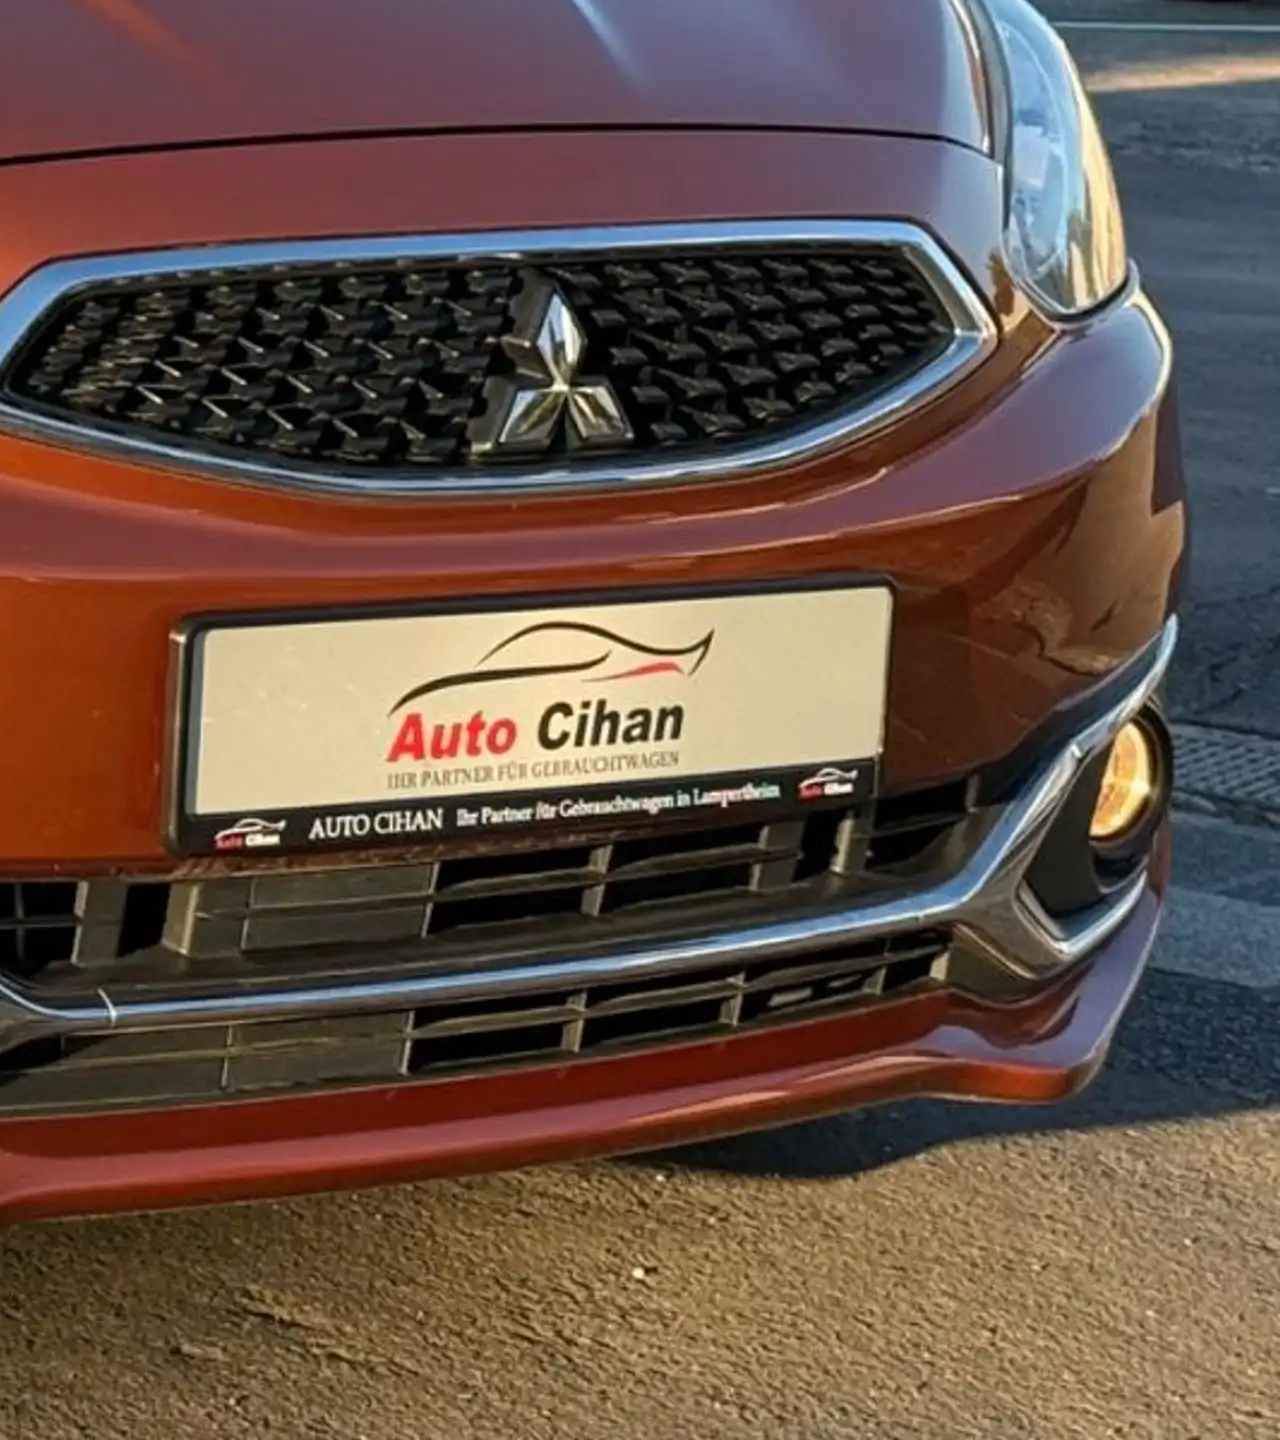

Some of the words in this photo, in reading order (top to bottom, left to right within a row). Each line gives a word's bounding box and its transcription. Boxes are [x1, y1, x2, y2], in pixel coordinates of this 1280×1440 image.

[385, 710, 518, 763] Auto
[537, 698, 685, 751] Cihan
[387, 771, 418, 790] IHR
[420, 763, 492, 788] PARTNER
[497, 760, 528, 782] FÜR
[531, 750, 680, 779] GEBRAUCHTWAGEN
[308, 814, 371, 840] AUTO
[373, 807, 443, 833] CIHAN
[480, 805, 533, 825] Partner
[535, 800, 557, 821] für
[559, 793, 674, 818] Gebrauchtwagen
[676, 788, 691, 808] in
